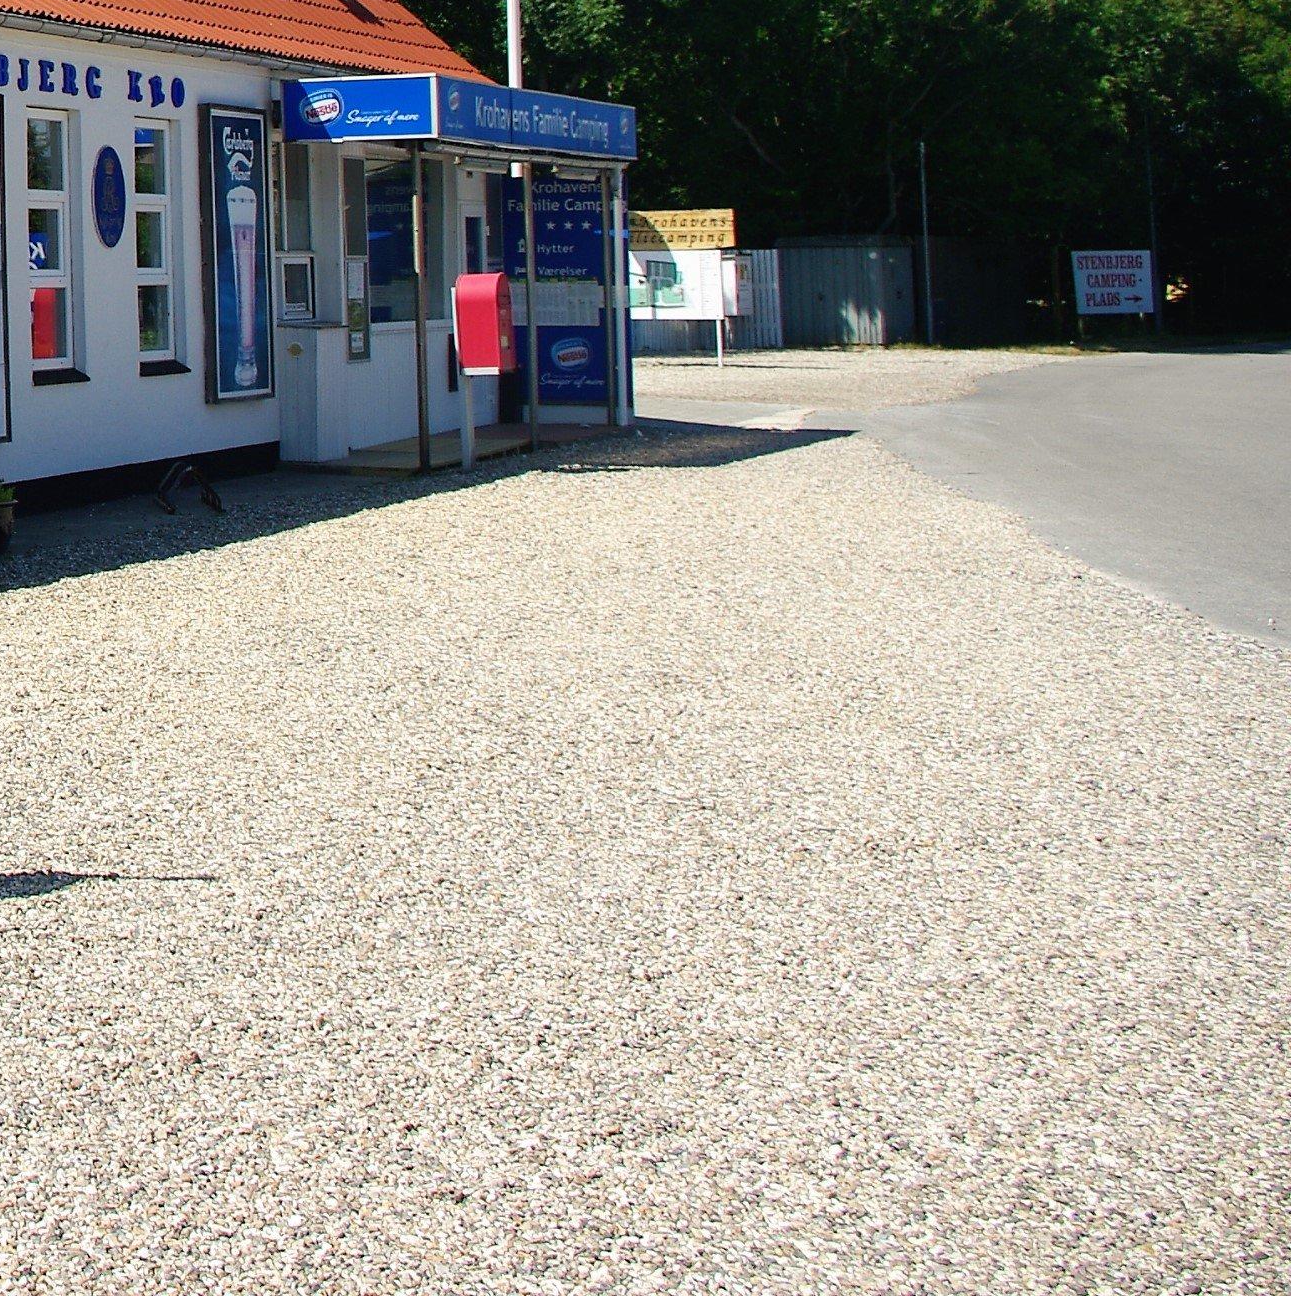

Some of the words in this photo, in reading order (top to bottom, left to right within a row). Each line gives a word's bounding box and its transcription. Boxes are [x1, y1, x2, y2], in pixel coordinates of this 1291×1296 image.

[126, 69, 186, 108] KRO
[305, 102, 339, 120] Nestlé
[475, 95, 530, 133] Krohavens
[533, 105, 569, 138] Familie
[571, 110, 609, 149] Camping
[223, 126, 254, 158] Carlsberg
[537, 244, 575, 255] Hytter
[1076, 255, 1143, 270] STENBJERG
[537, 266, 588, 276] Værelser
[1084, 292, 1121, 307] PLADS
